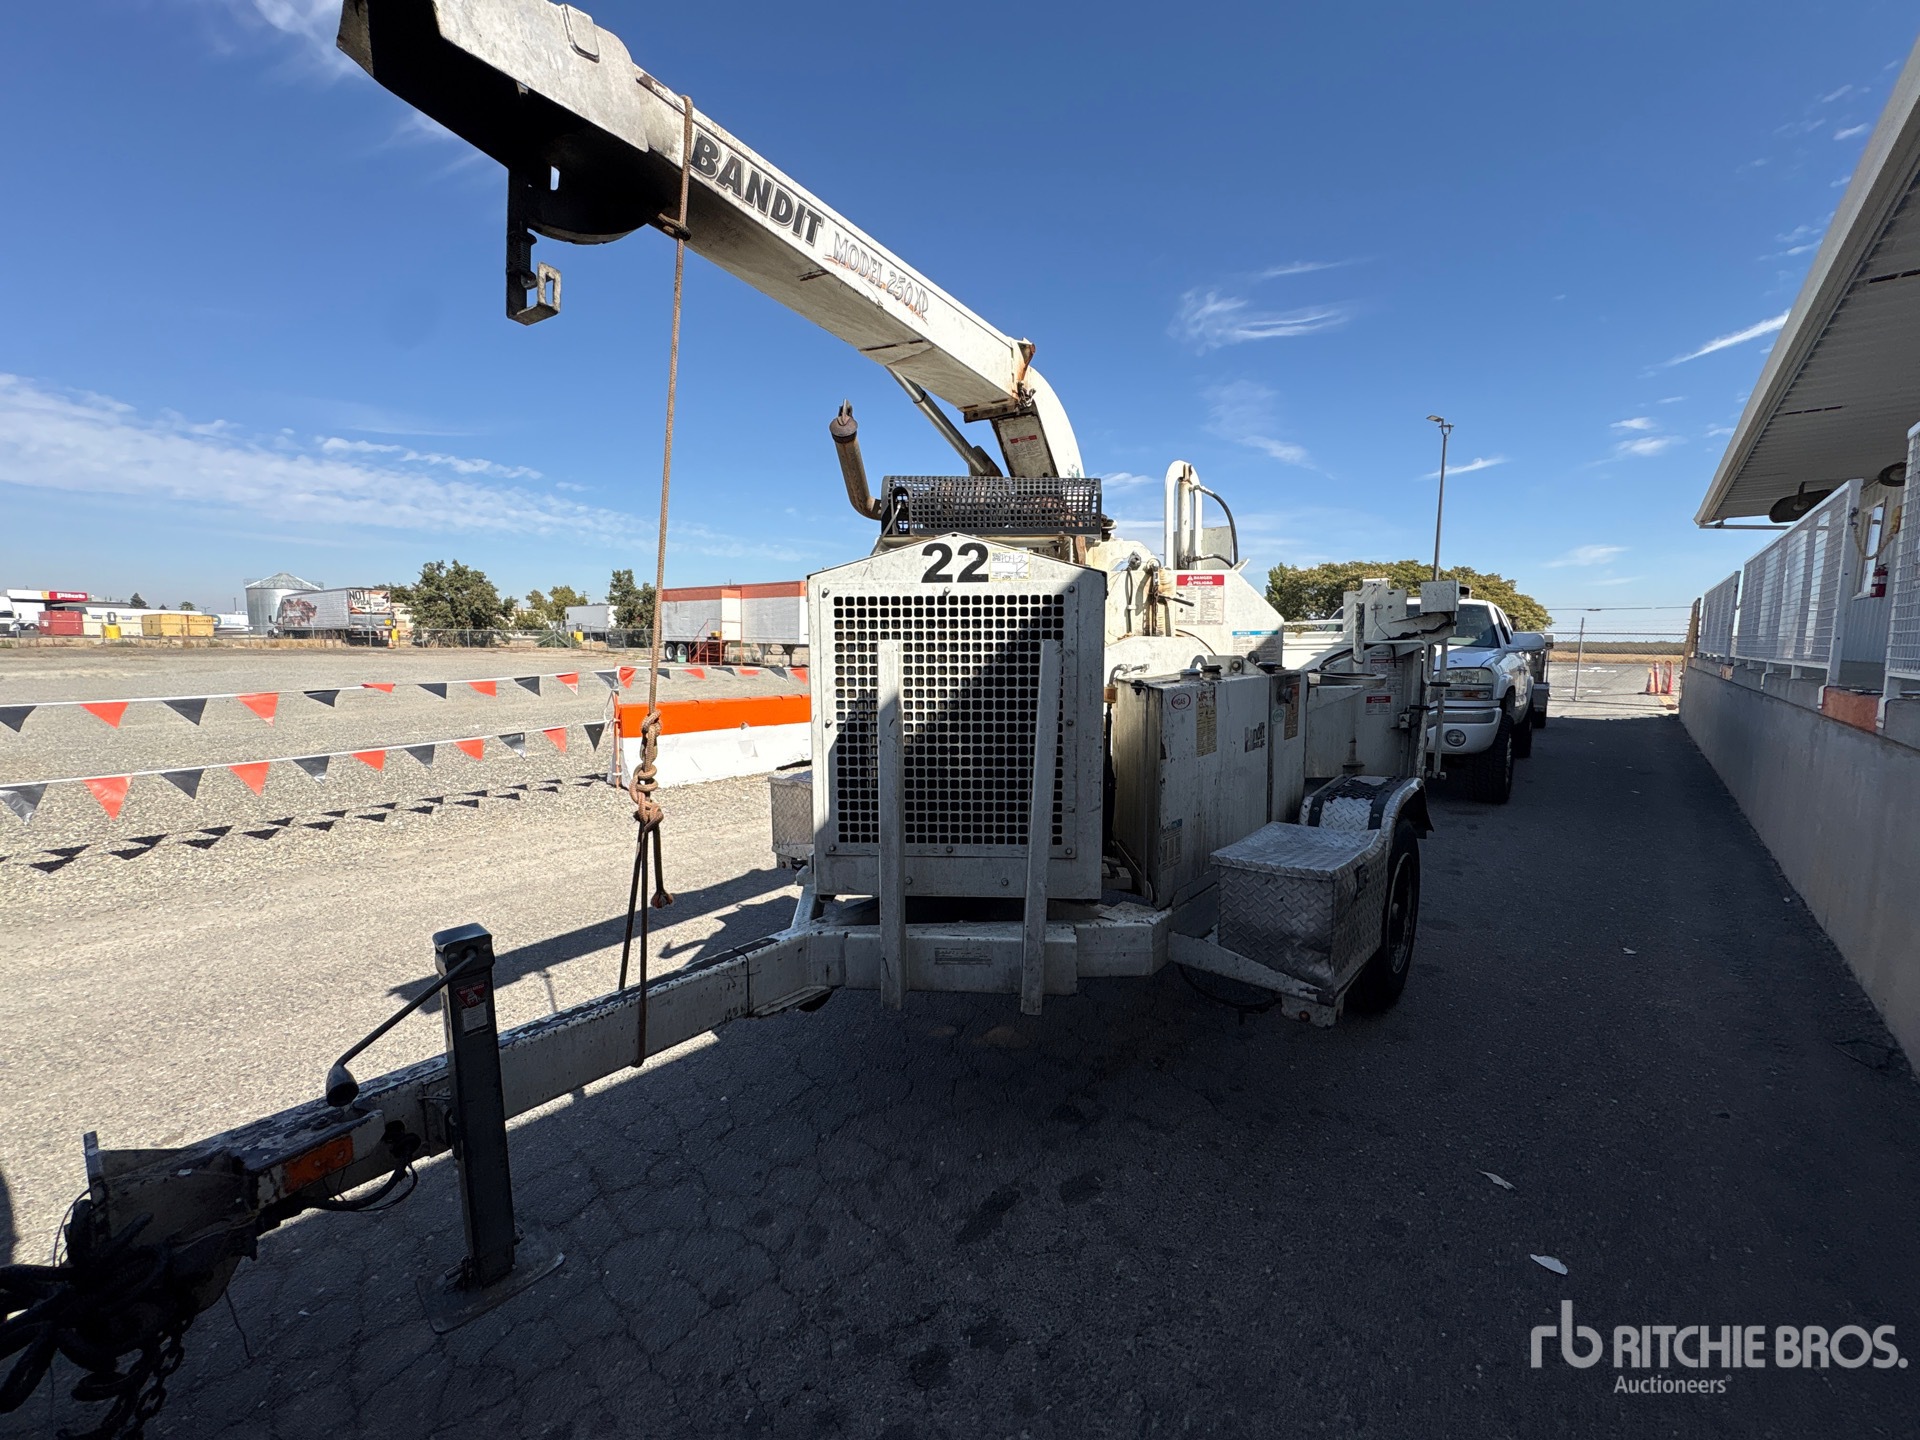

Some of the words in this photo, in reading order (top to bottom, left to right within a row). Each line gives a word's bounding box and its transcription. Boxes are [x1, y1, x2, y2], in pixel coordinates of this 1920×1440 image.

[690, 128, 824, 246] BANDIT
[832, 231, 883, 289] MODEL
[921, 542, 989, 583] 22
[349, 590, 366, 601] NOT
